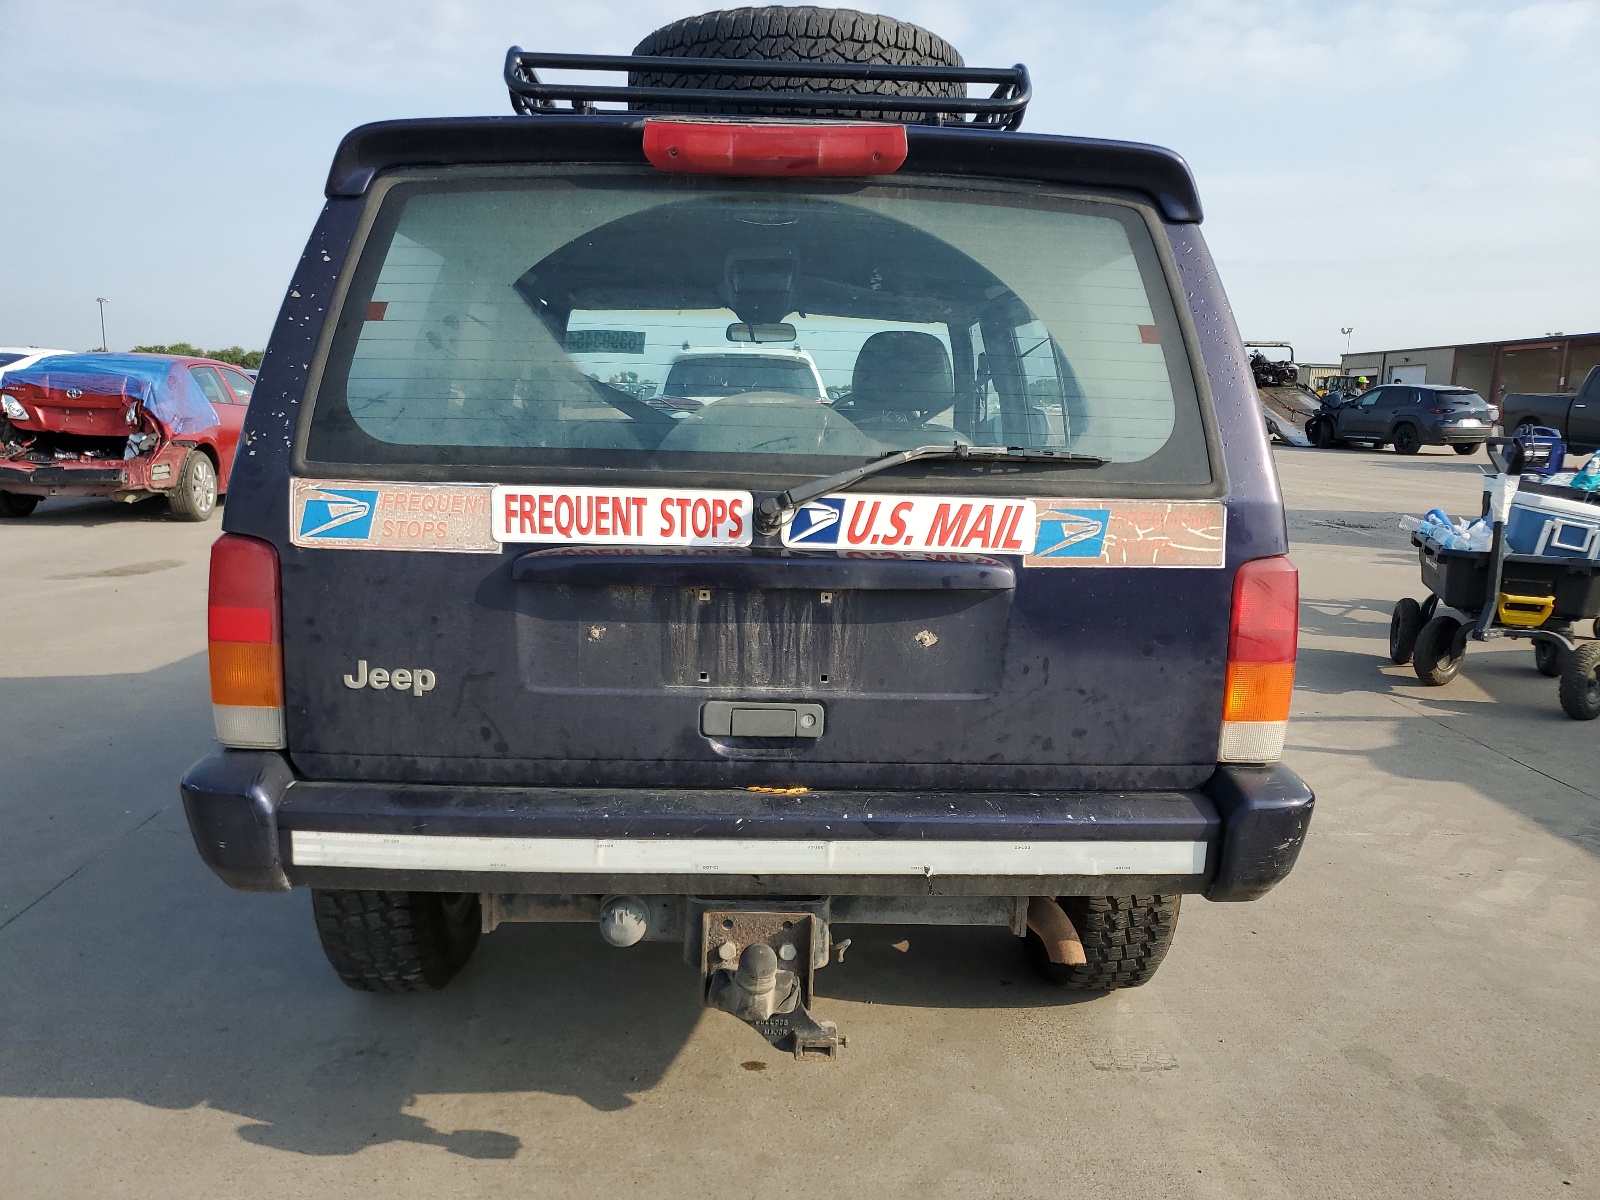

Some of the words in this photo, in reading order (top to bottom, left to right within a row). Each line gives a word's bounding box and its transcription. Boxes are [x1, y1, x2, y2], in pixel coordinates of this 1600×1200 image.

[381, 494, 490, 513] FREQUENT
[505, 494, 648, 538] FREQUENT
[660, 497, 744, 538] STOPS
[381, 520, 448, 540] STOPS
[847, 501, 913, 546] U.S.
[925, 504, 1025, 549] MAIL
[343, 660, 436, 697] Jeep
